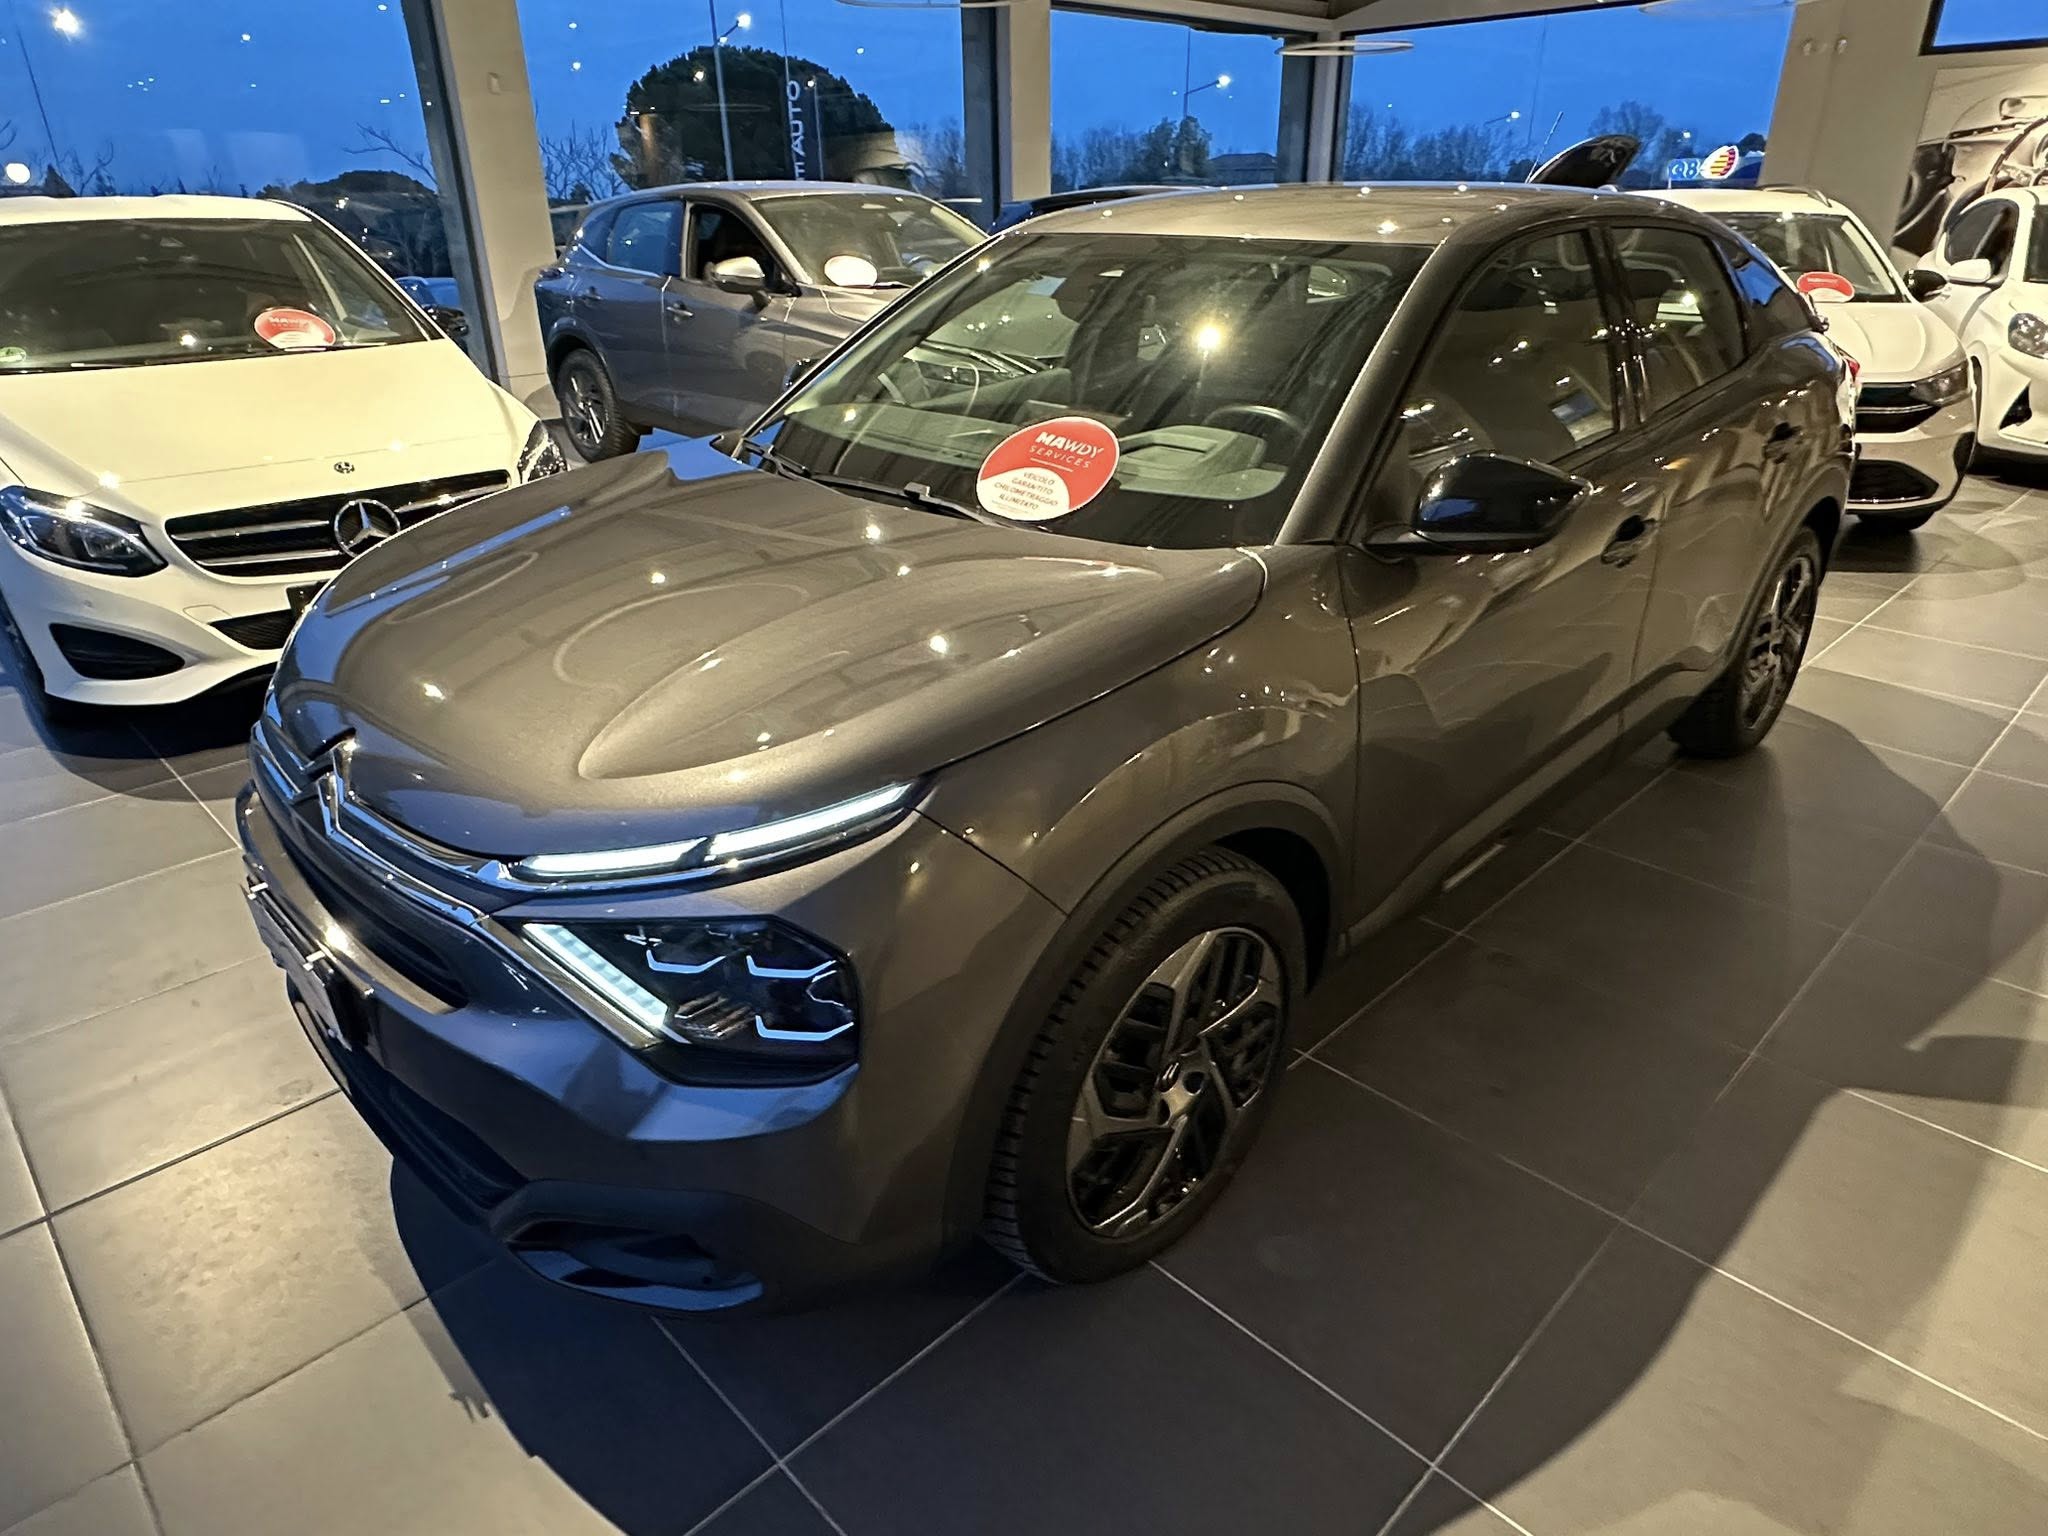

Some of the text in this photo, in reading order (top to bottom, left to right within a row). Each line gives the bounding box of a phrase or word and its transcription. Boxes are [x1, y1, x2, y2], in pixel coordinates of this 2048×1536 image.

[786, 80, 806, 157] AUTO
[1035, 431, 1104, 458] MAWDY
[1029, 446, 1091, 468] SERVICES
[1011, 477, 1053, 495] GARANTITO
[1023, 472, 1055, 485] VEICOLO
